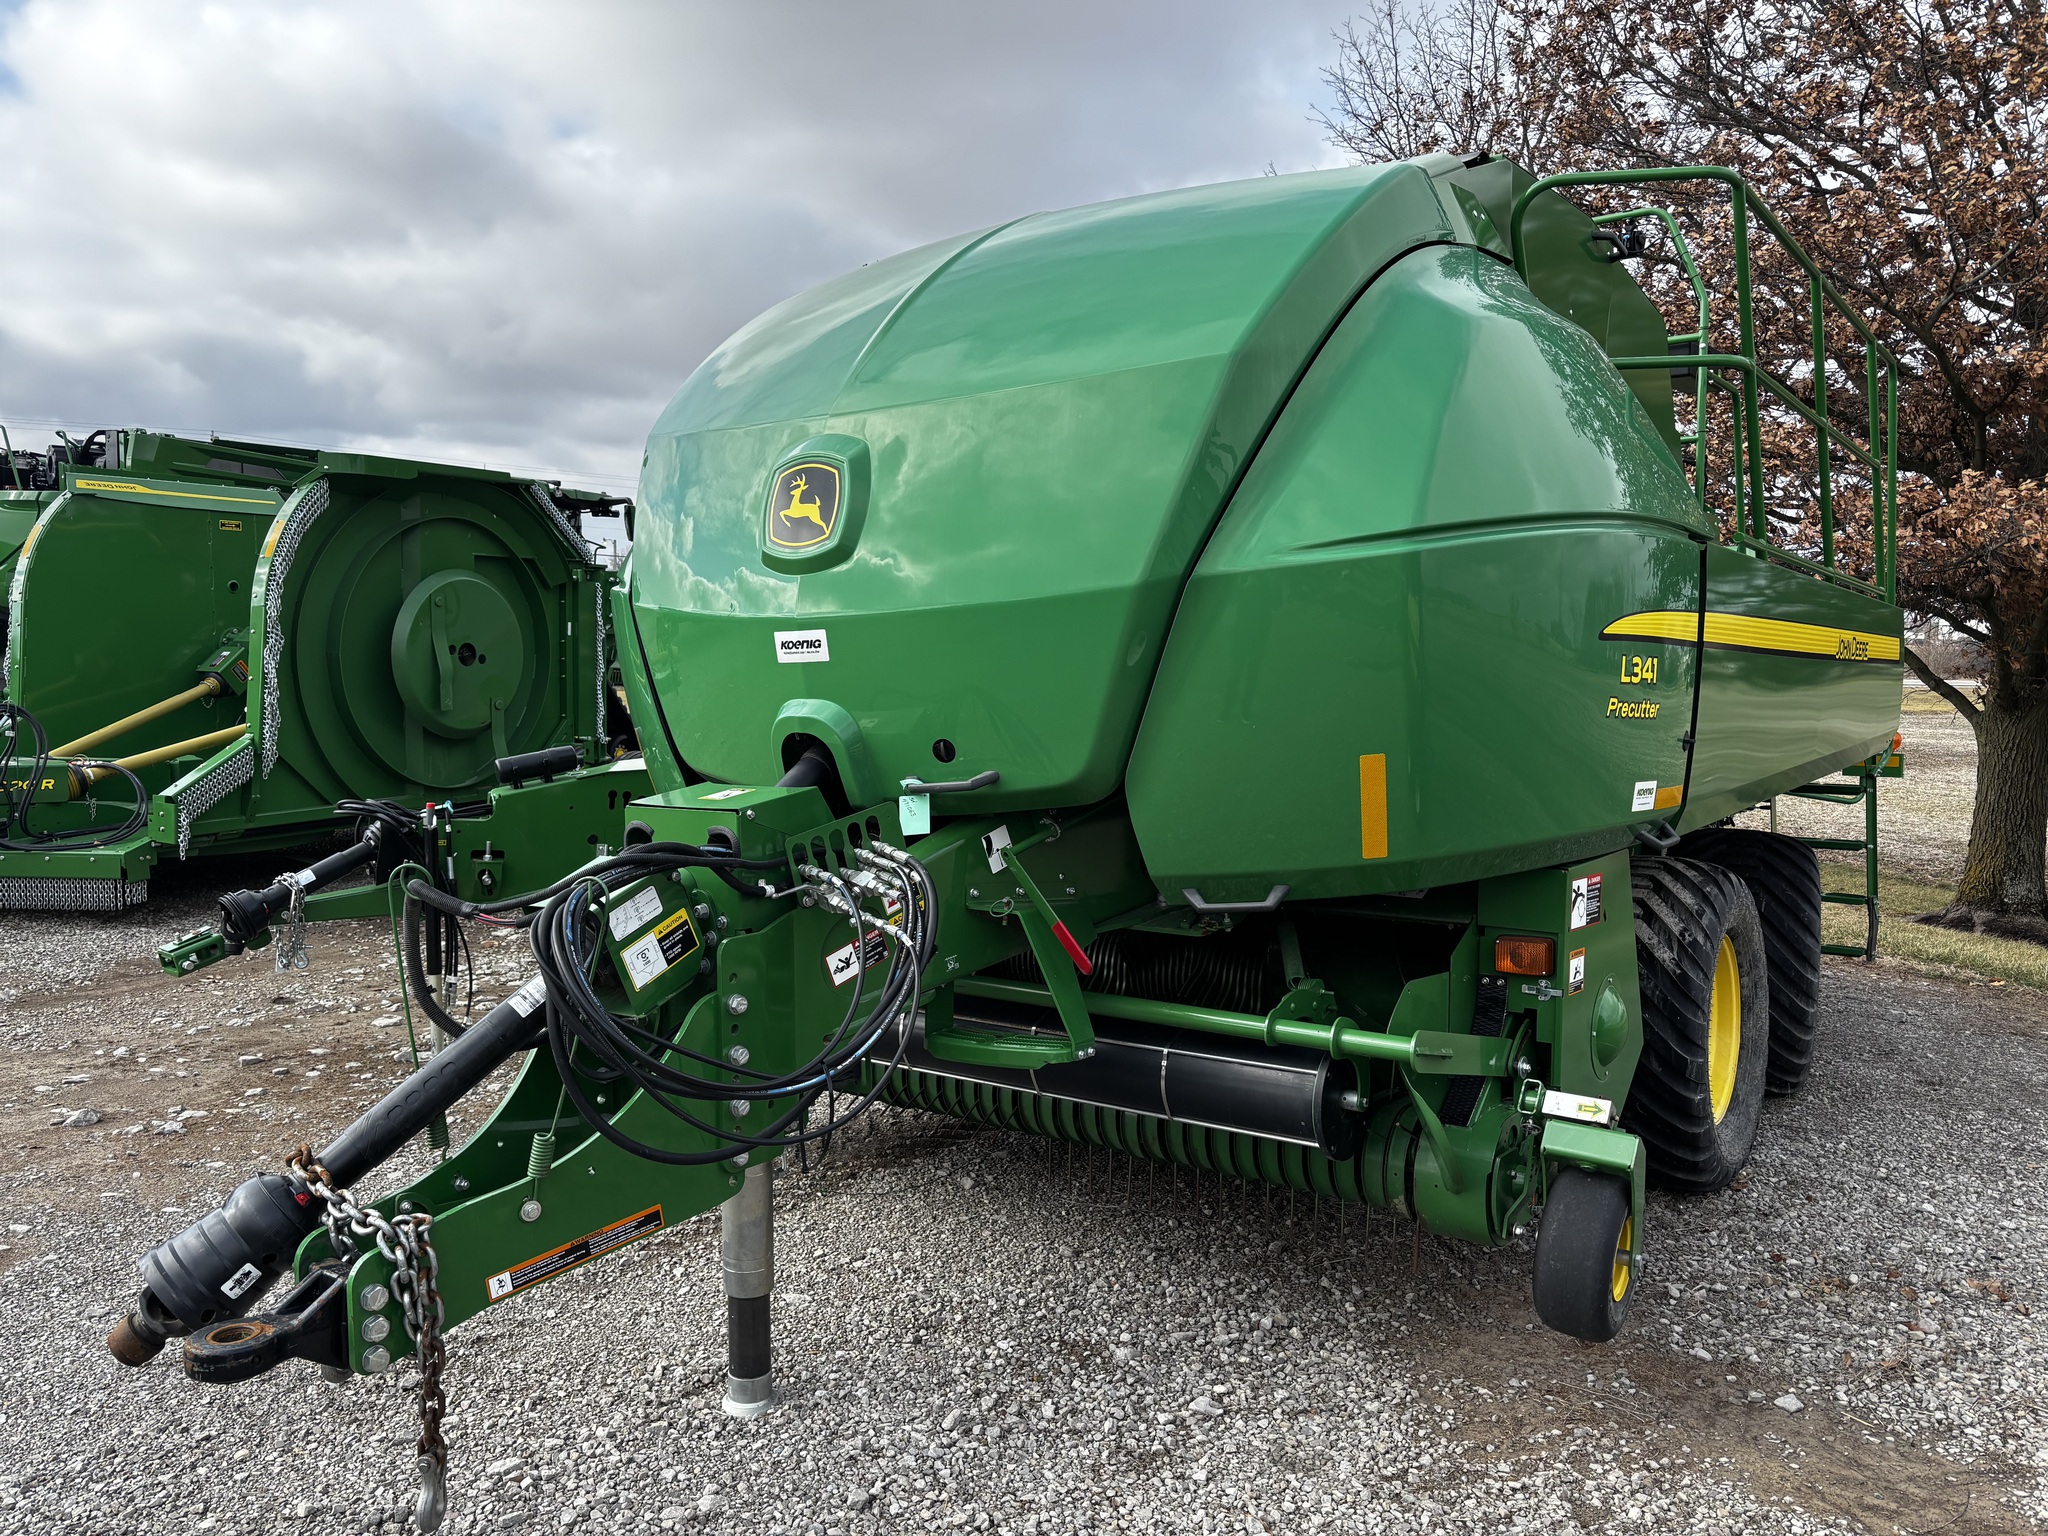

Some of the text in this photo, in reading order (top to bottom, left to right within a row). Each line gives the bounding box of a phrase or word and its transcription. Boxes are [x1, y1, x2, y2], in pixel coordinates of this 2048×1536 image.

[1620, 654, 1659, 684] L341
[1606, 697, 1660, 718] Precutter
[662, 914, 684, 931] CAUTION
[575, 1229, 604, 1244] WARNING
